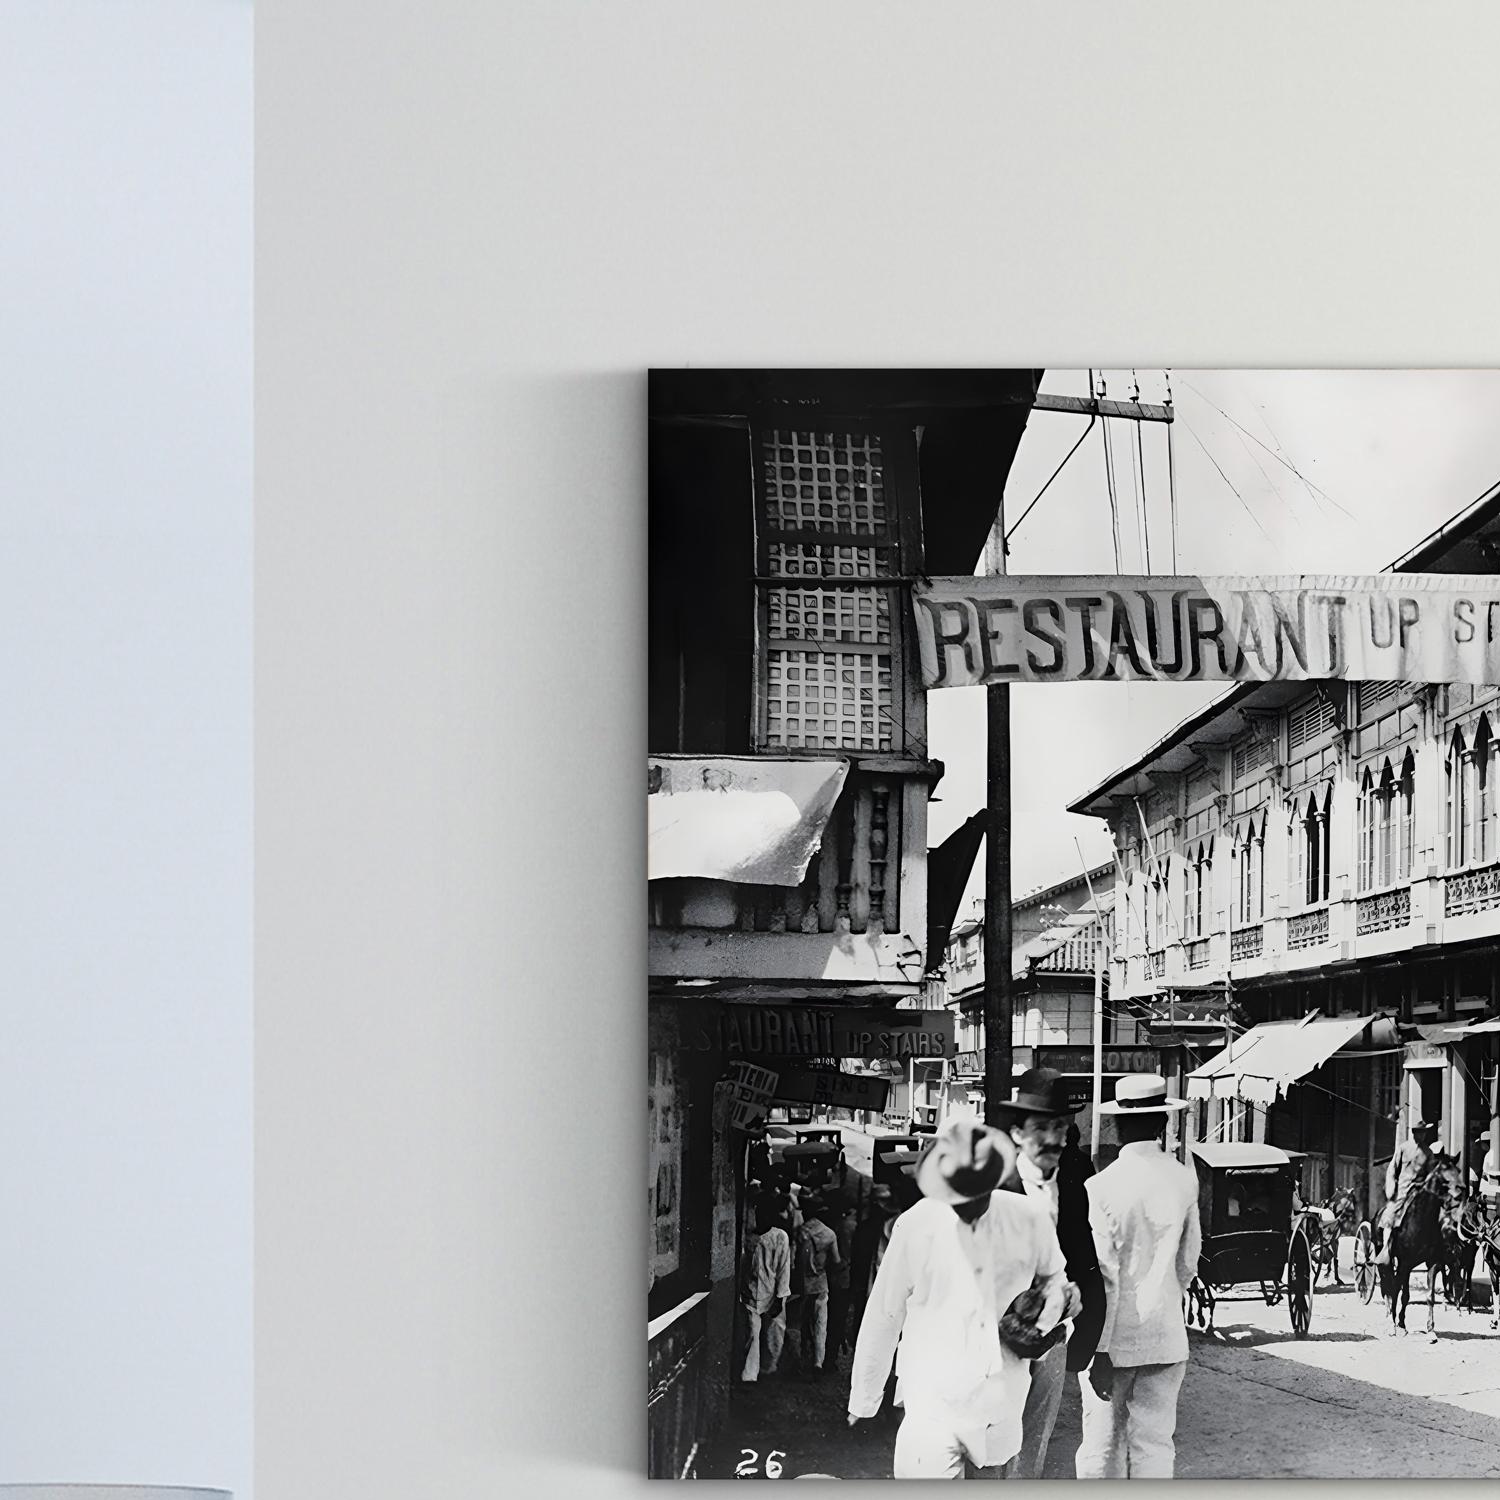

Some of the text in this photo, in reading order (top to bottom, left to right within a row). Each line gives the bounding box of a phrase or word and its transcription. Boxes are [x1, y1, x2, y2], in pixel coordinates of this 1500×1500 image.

[914, 589, 1347, 687] RESTAURANT
[1369, 592, 1420, 649] UP
[878, 1031, 946, 1056] STAIRS
[734, 1449, 787, 1480] 26
